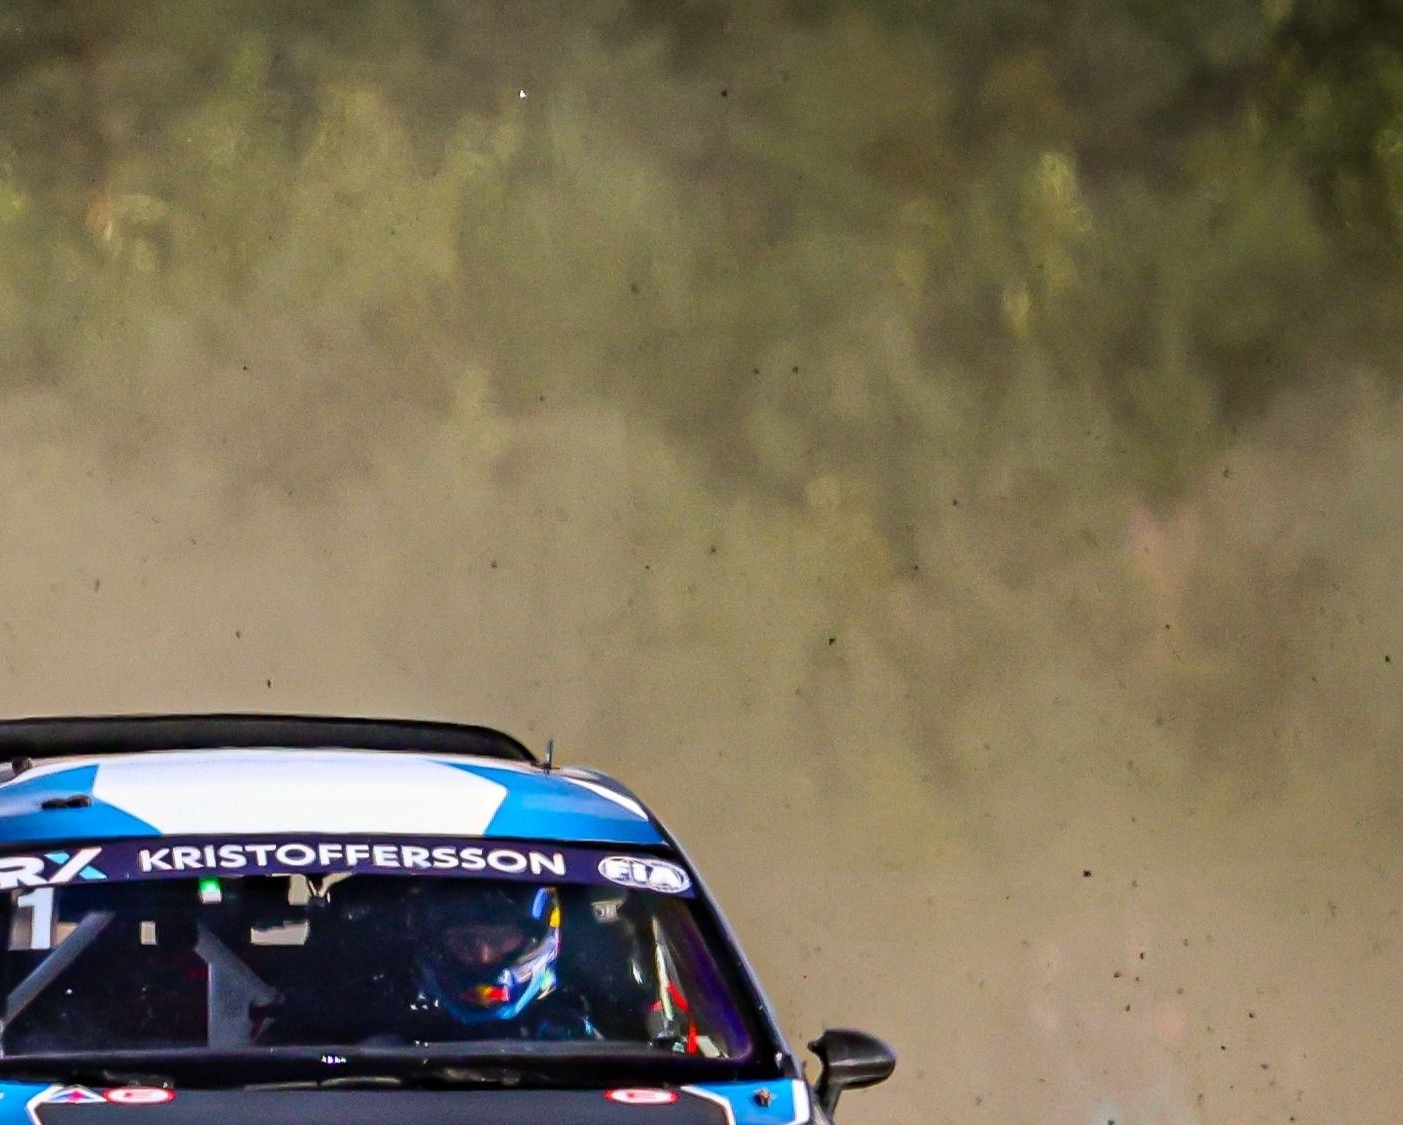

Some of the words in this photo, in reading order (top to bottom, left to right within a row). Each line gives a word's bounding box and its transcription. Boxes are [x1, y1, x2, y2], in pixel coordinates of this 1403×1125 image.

[139, 843, 566, 876] KRISTOFFERSSON
[601, 856, 687, 892] FIA
[17, 887, 54, 950] 1
